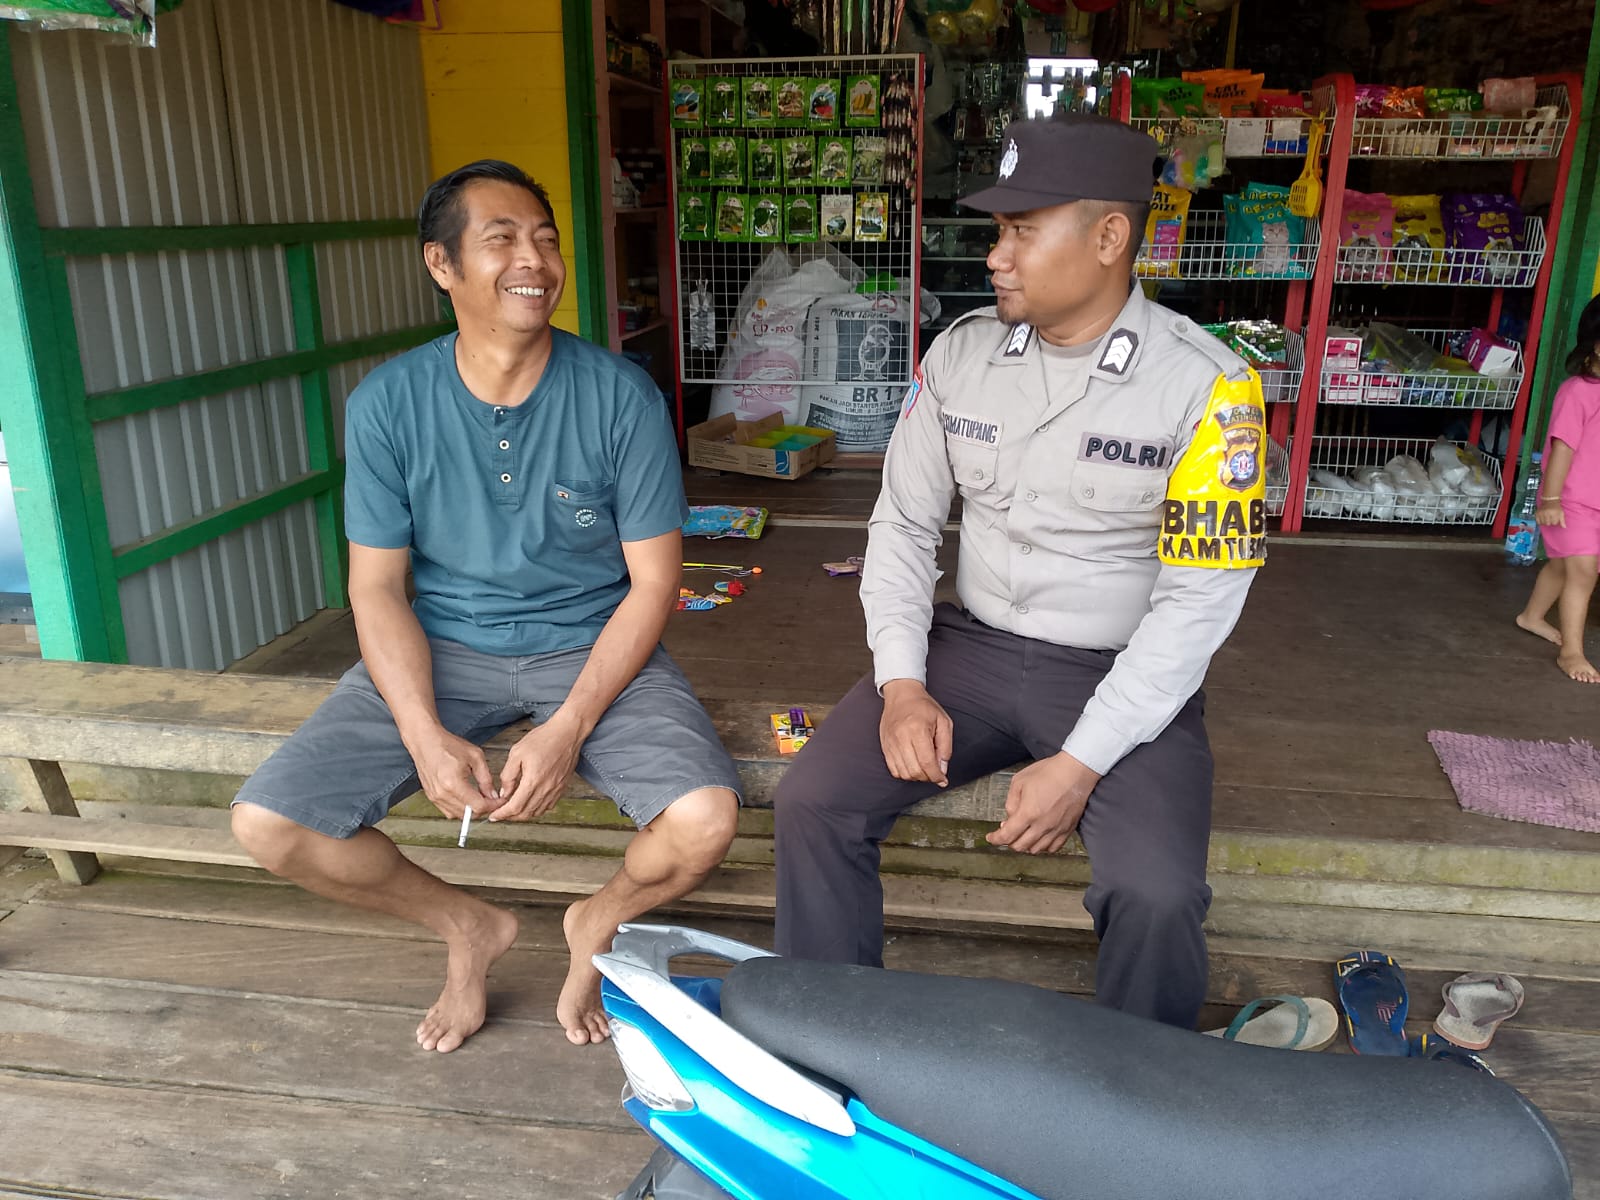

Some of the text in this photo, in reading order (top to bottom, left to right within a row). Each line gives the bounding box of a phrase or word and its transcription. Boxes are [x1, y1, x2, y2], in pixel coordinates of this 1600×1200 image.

[1153, 191, 1171, 201] AT
[852, 387, 879, 403] BR
[1085, 436, 1167, 468] POLRI
